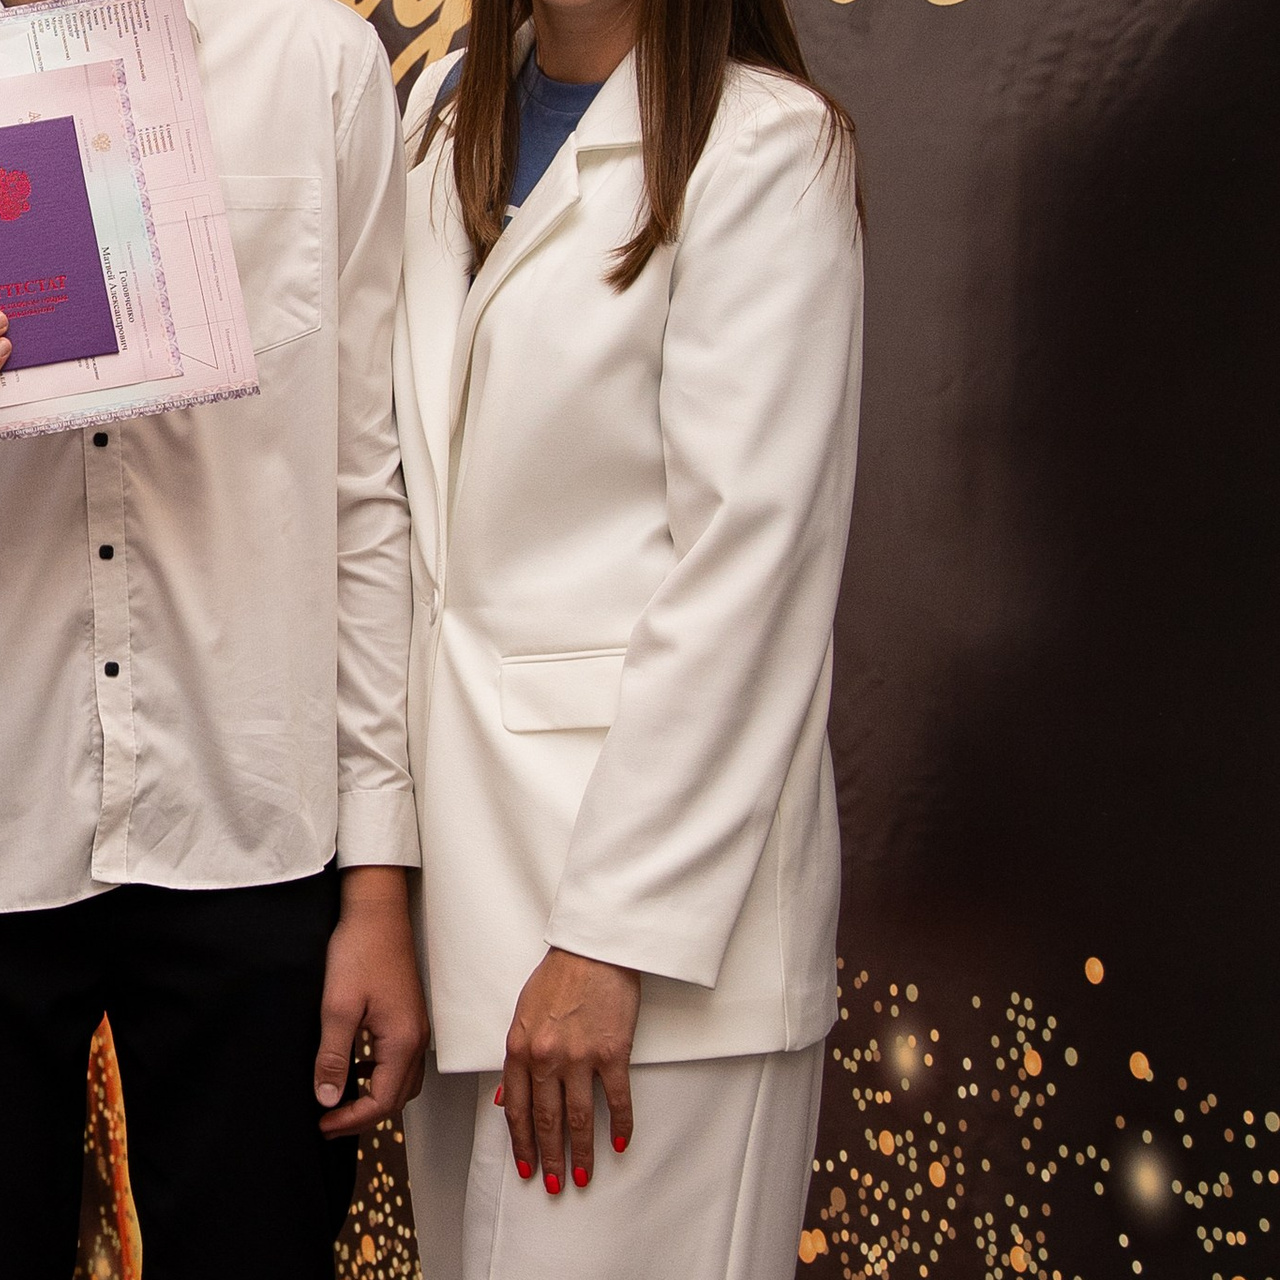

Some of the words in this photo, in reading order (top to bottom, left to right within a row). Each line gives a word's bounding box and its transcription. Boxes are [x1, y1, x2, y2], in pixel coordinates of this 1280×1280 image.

[100, 245, 116, 281] Матвей
[106, 281, 130, 352] Александрович
[117, 269, 138, 323] Головченко
